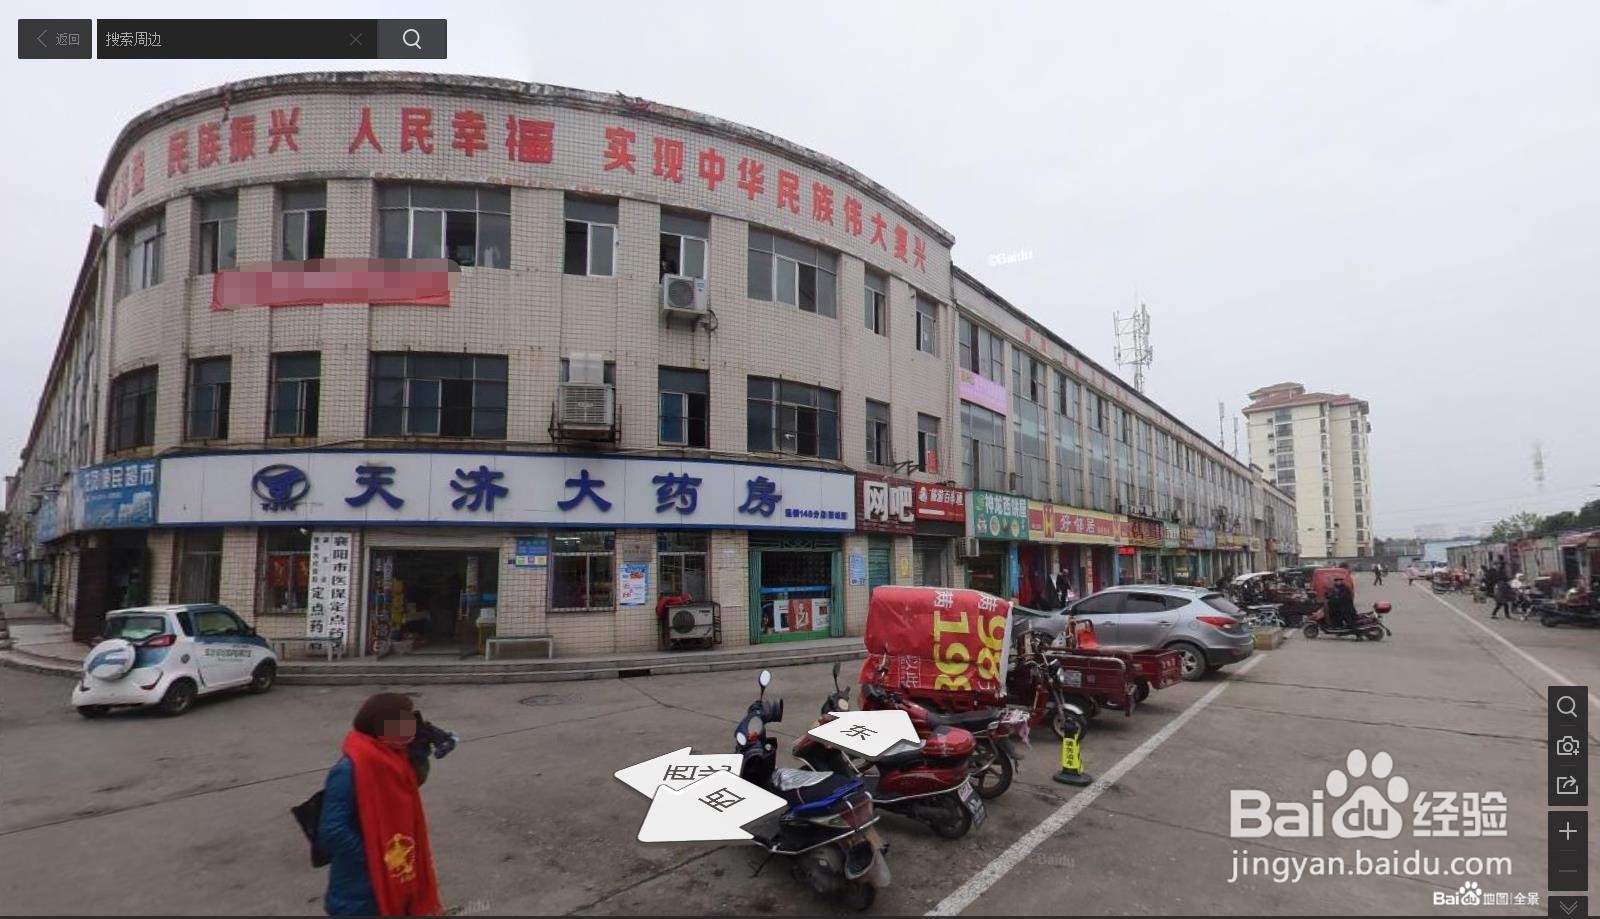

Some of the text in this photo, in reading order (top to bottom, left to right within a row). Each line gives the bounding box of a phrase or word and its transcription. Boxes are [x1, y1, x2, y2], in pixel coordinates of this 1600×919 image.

[168, 107, 929, 274] 民族振兴 人民幸福 实现中华民族伟大复兴
[344, 464, 783, 518] 天济大药房
[863, 480, 915, 522] 网吧
